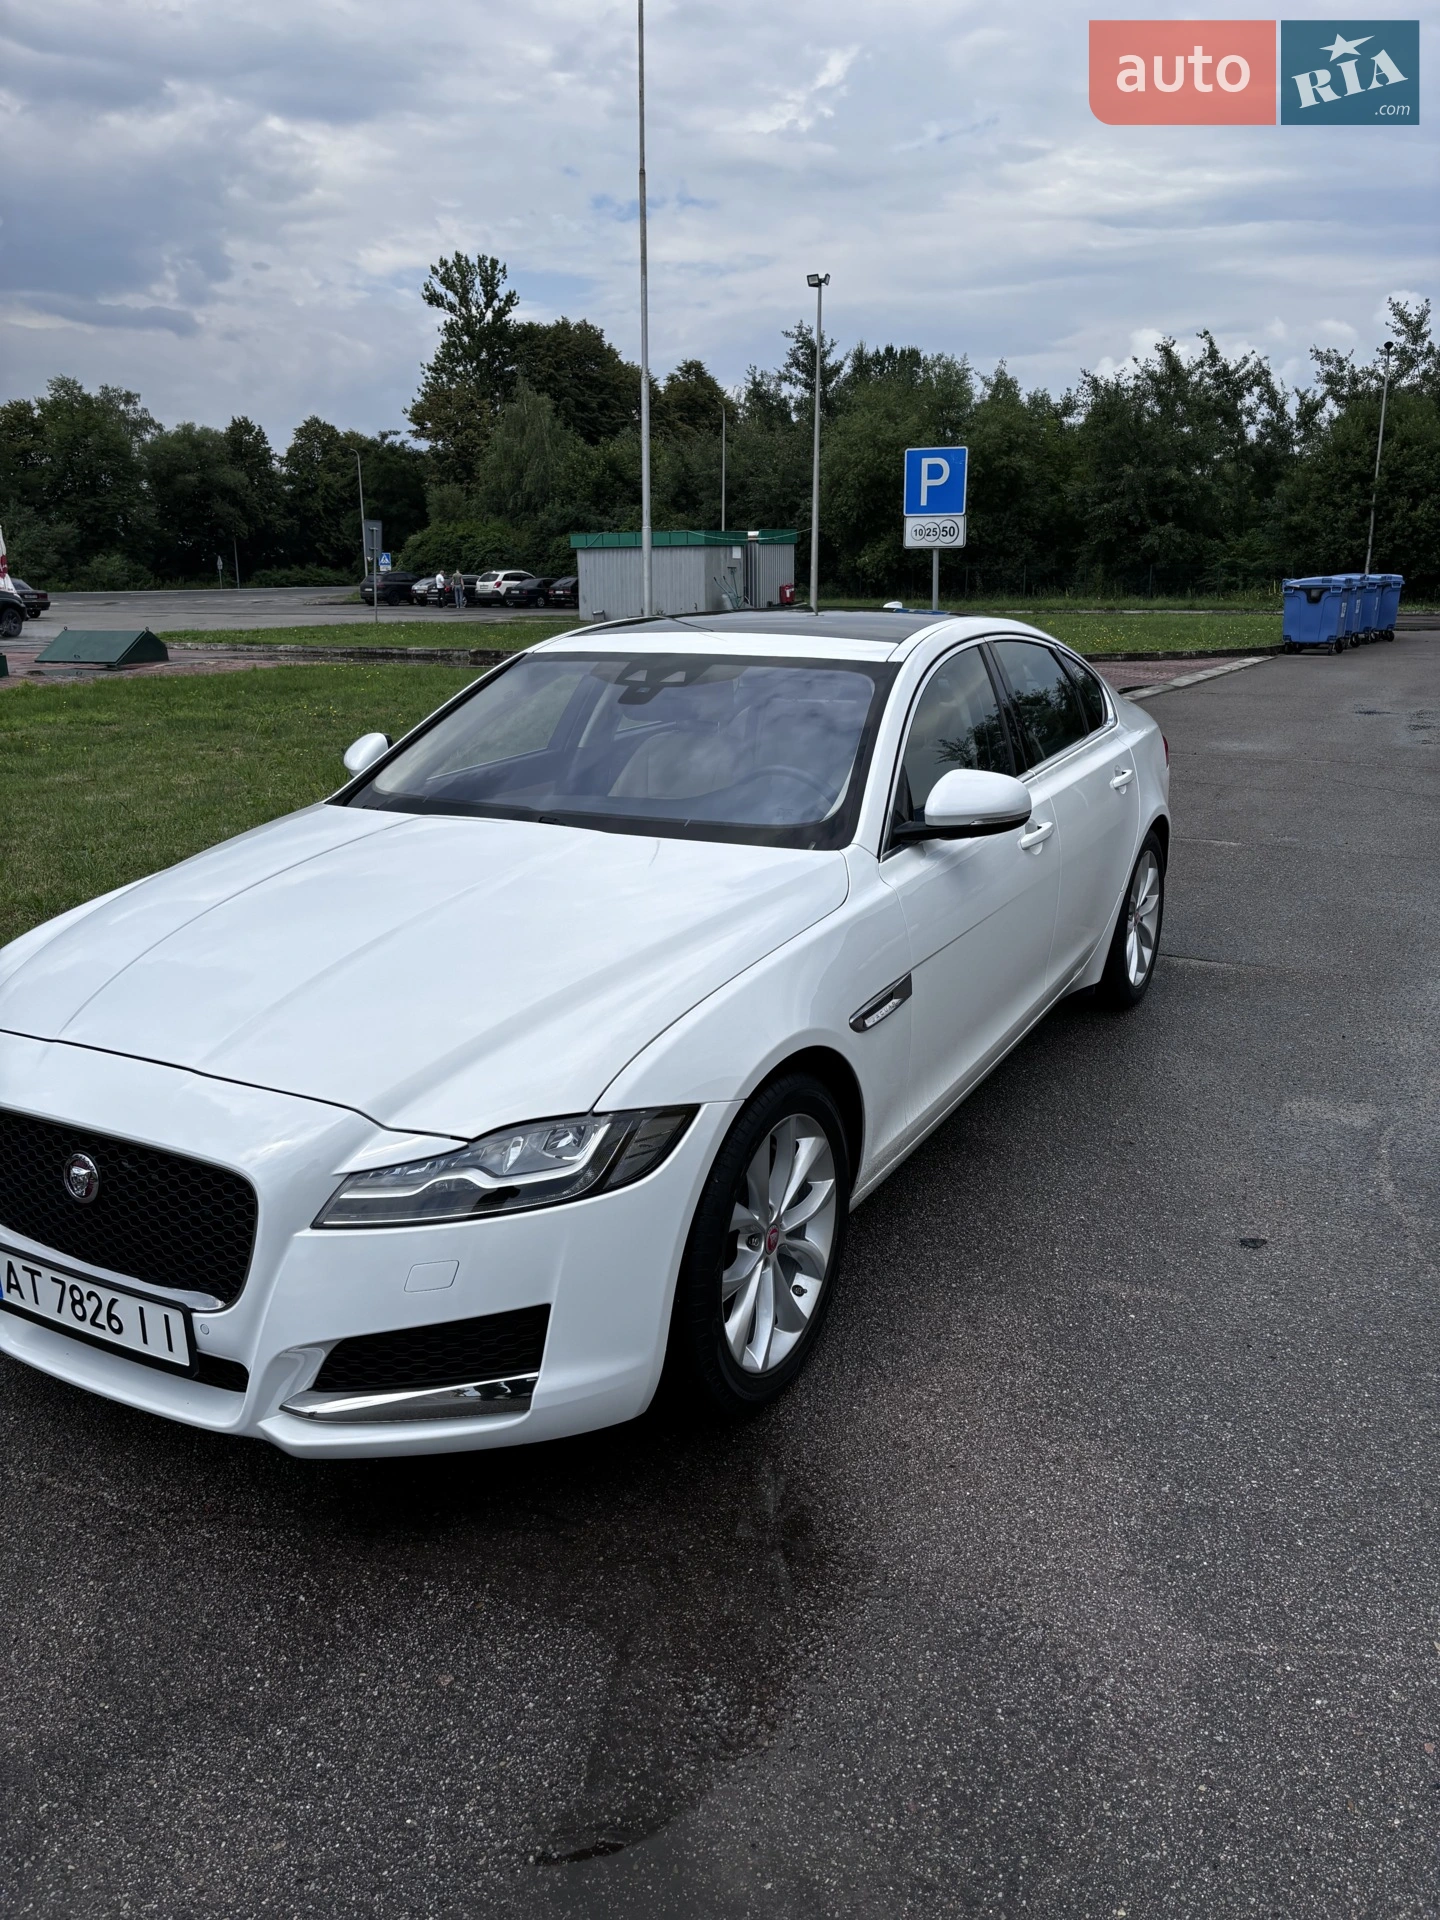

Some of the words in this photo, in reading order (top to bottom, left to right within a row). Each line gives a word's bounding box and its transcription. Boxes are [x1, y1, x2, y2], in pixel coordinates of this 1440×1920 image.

[920, 457, 950, 506] P
[913, 528, 924, 537] 10
[926, 527, 938, 537] 25
[941, 526, 956, 537] 50
[6, 1260, 42, 1305] AT
[51, 1278, 124, 1335] 7826
